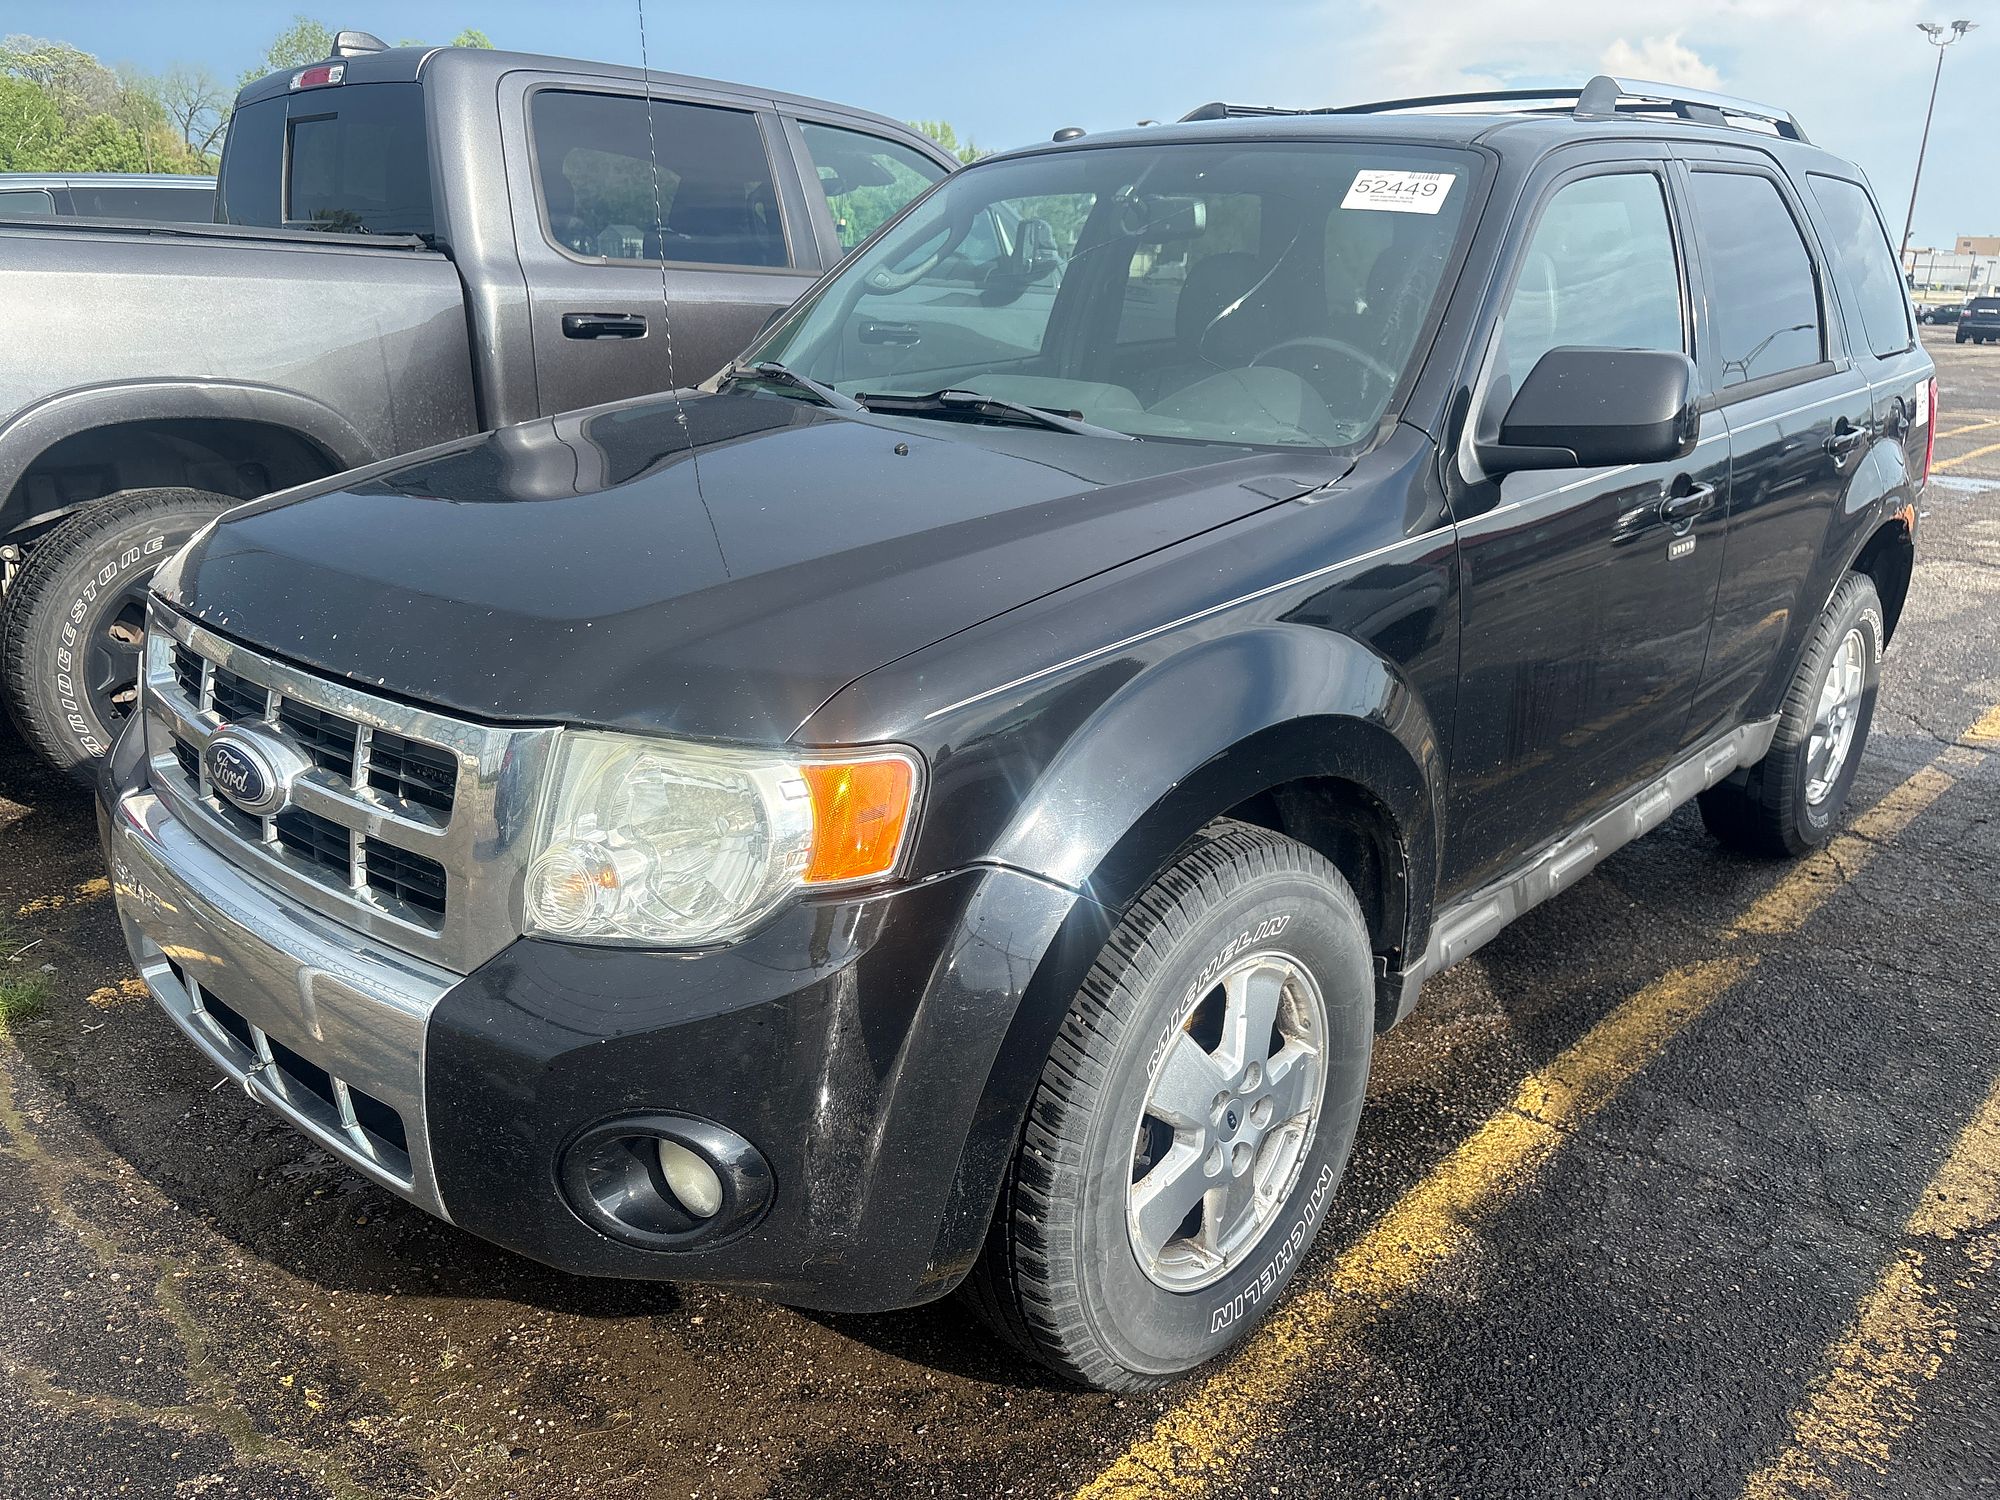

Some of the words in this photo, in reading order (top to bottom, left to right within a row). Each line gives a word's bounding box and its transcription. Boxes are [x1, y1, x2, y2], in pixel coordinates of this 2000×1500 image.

[1355, 179, 1438, 197] 52449
[57, 535, 165, 758] BRIDGESTONE
[213, 749, 249, 793] Ford
[1146, 915, 1291, 1080] MICHELIN
[1210, 1163, 1334, 1334] MICHELIN
